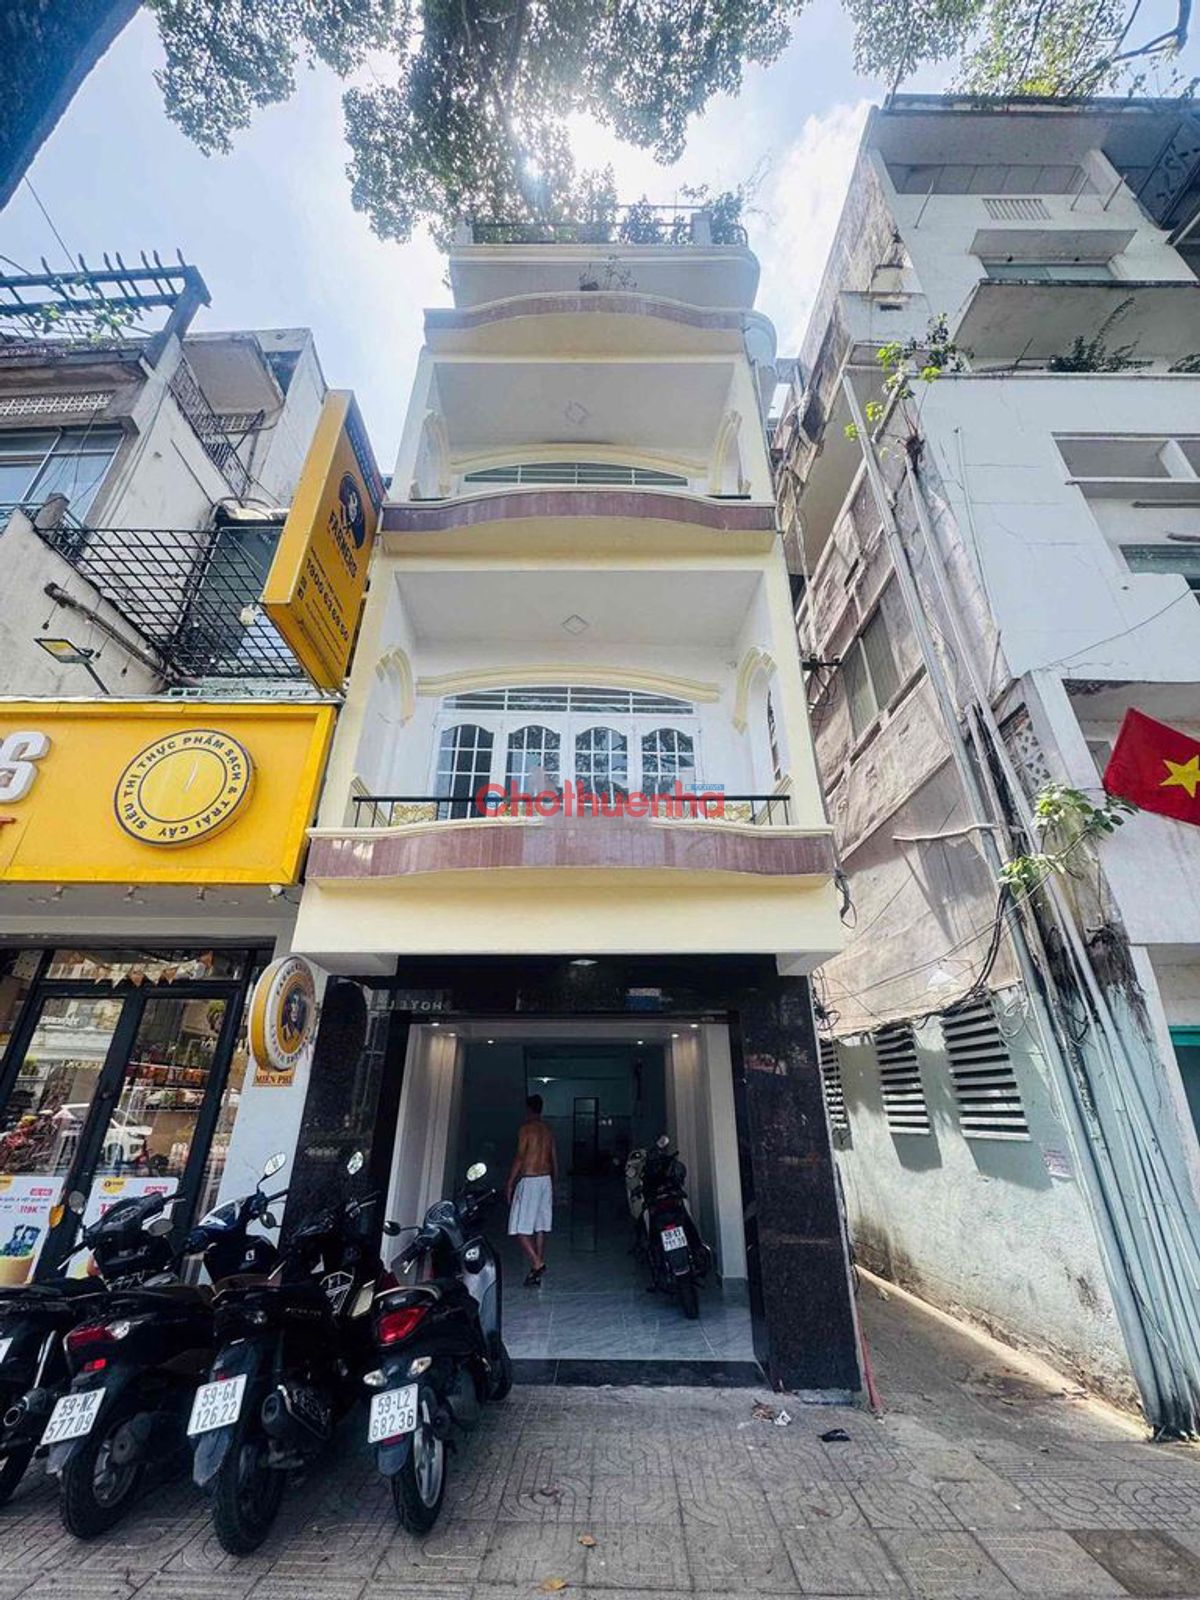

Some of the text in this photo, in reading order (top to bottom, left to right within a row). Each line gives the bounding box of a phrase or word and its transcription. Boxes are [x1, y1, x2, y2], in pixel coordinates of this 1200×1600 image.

[124, 734, 242, 838] SIÊU THỊ THỰC PHẨM SẠCH & TRÁI CÂY
[59, 1393, 96, 1417] 59-N2
[195, 1401, 237, 1429] 126.22
[377, 1388, 410, 1415] 59-L2
[45, 1412, 94, 1440] 577.09
